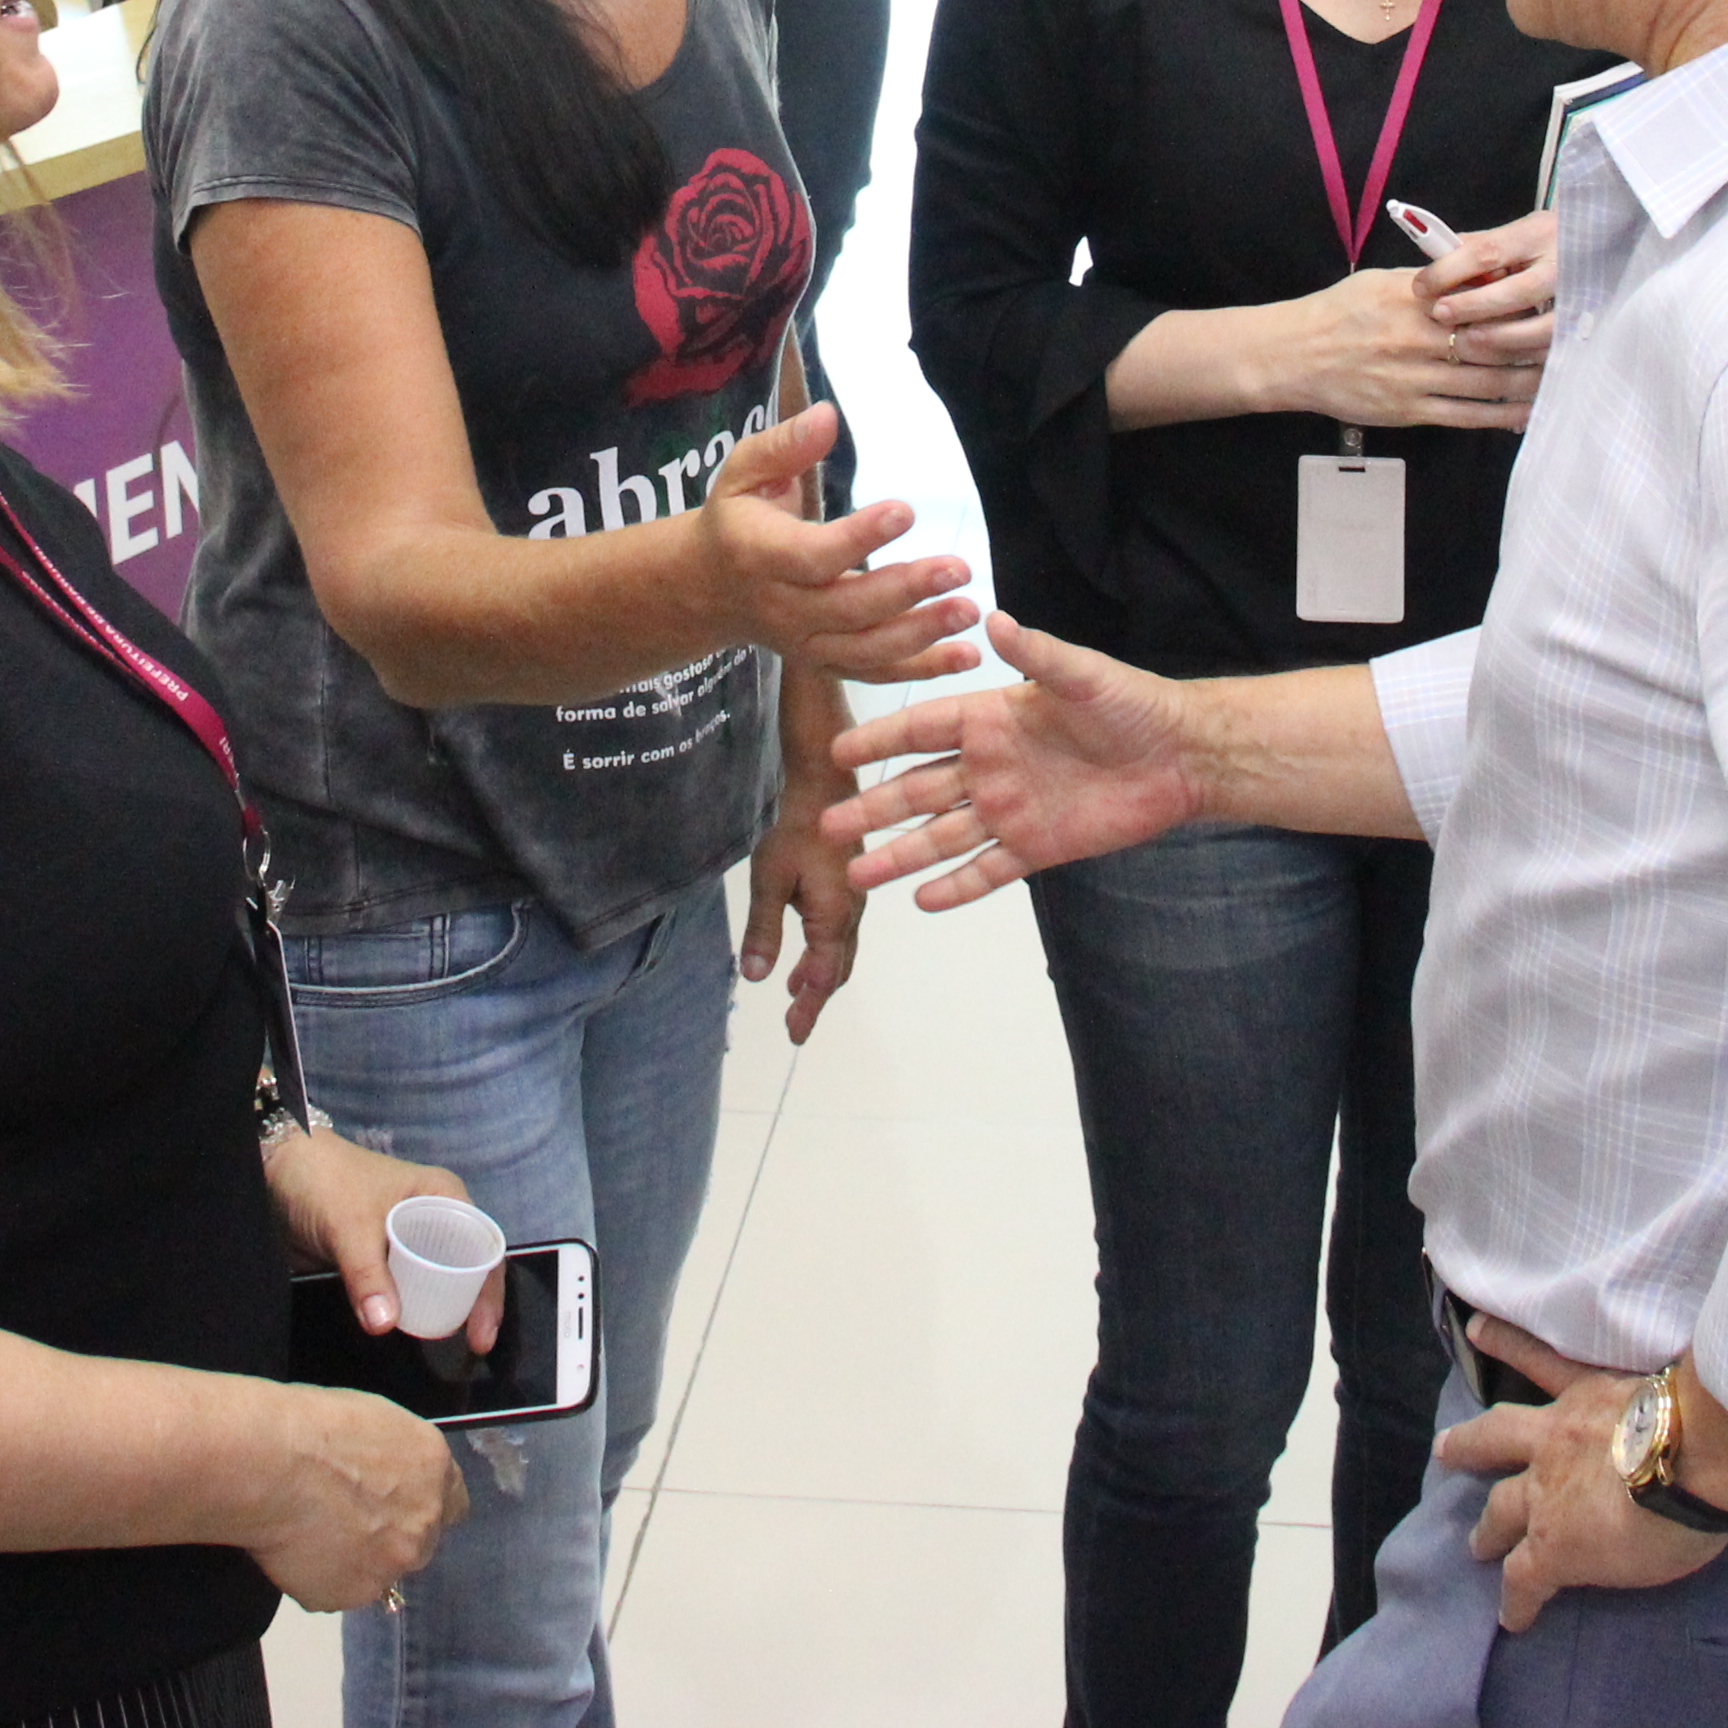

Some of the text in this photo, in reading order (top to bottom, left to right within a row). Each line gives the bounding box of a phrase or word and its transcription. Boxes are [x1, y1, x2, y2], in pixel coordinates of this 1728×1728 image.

[527, 379, 779, 540] abra
[105, 624, 190, 702] PREFEITURA
[555, 704, 617, 722] forma
[623, 700, 647, 719] de
[651, 690, 694, 715] salvar
[562, 748, 576, 771] É
[582, 750, 635, 771] sorrir
[640, 744, 675, 764] com
[678, 737, 694, 754] os
